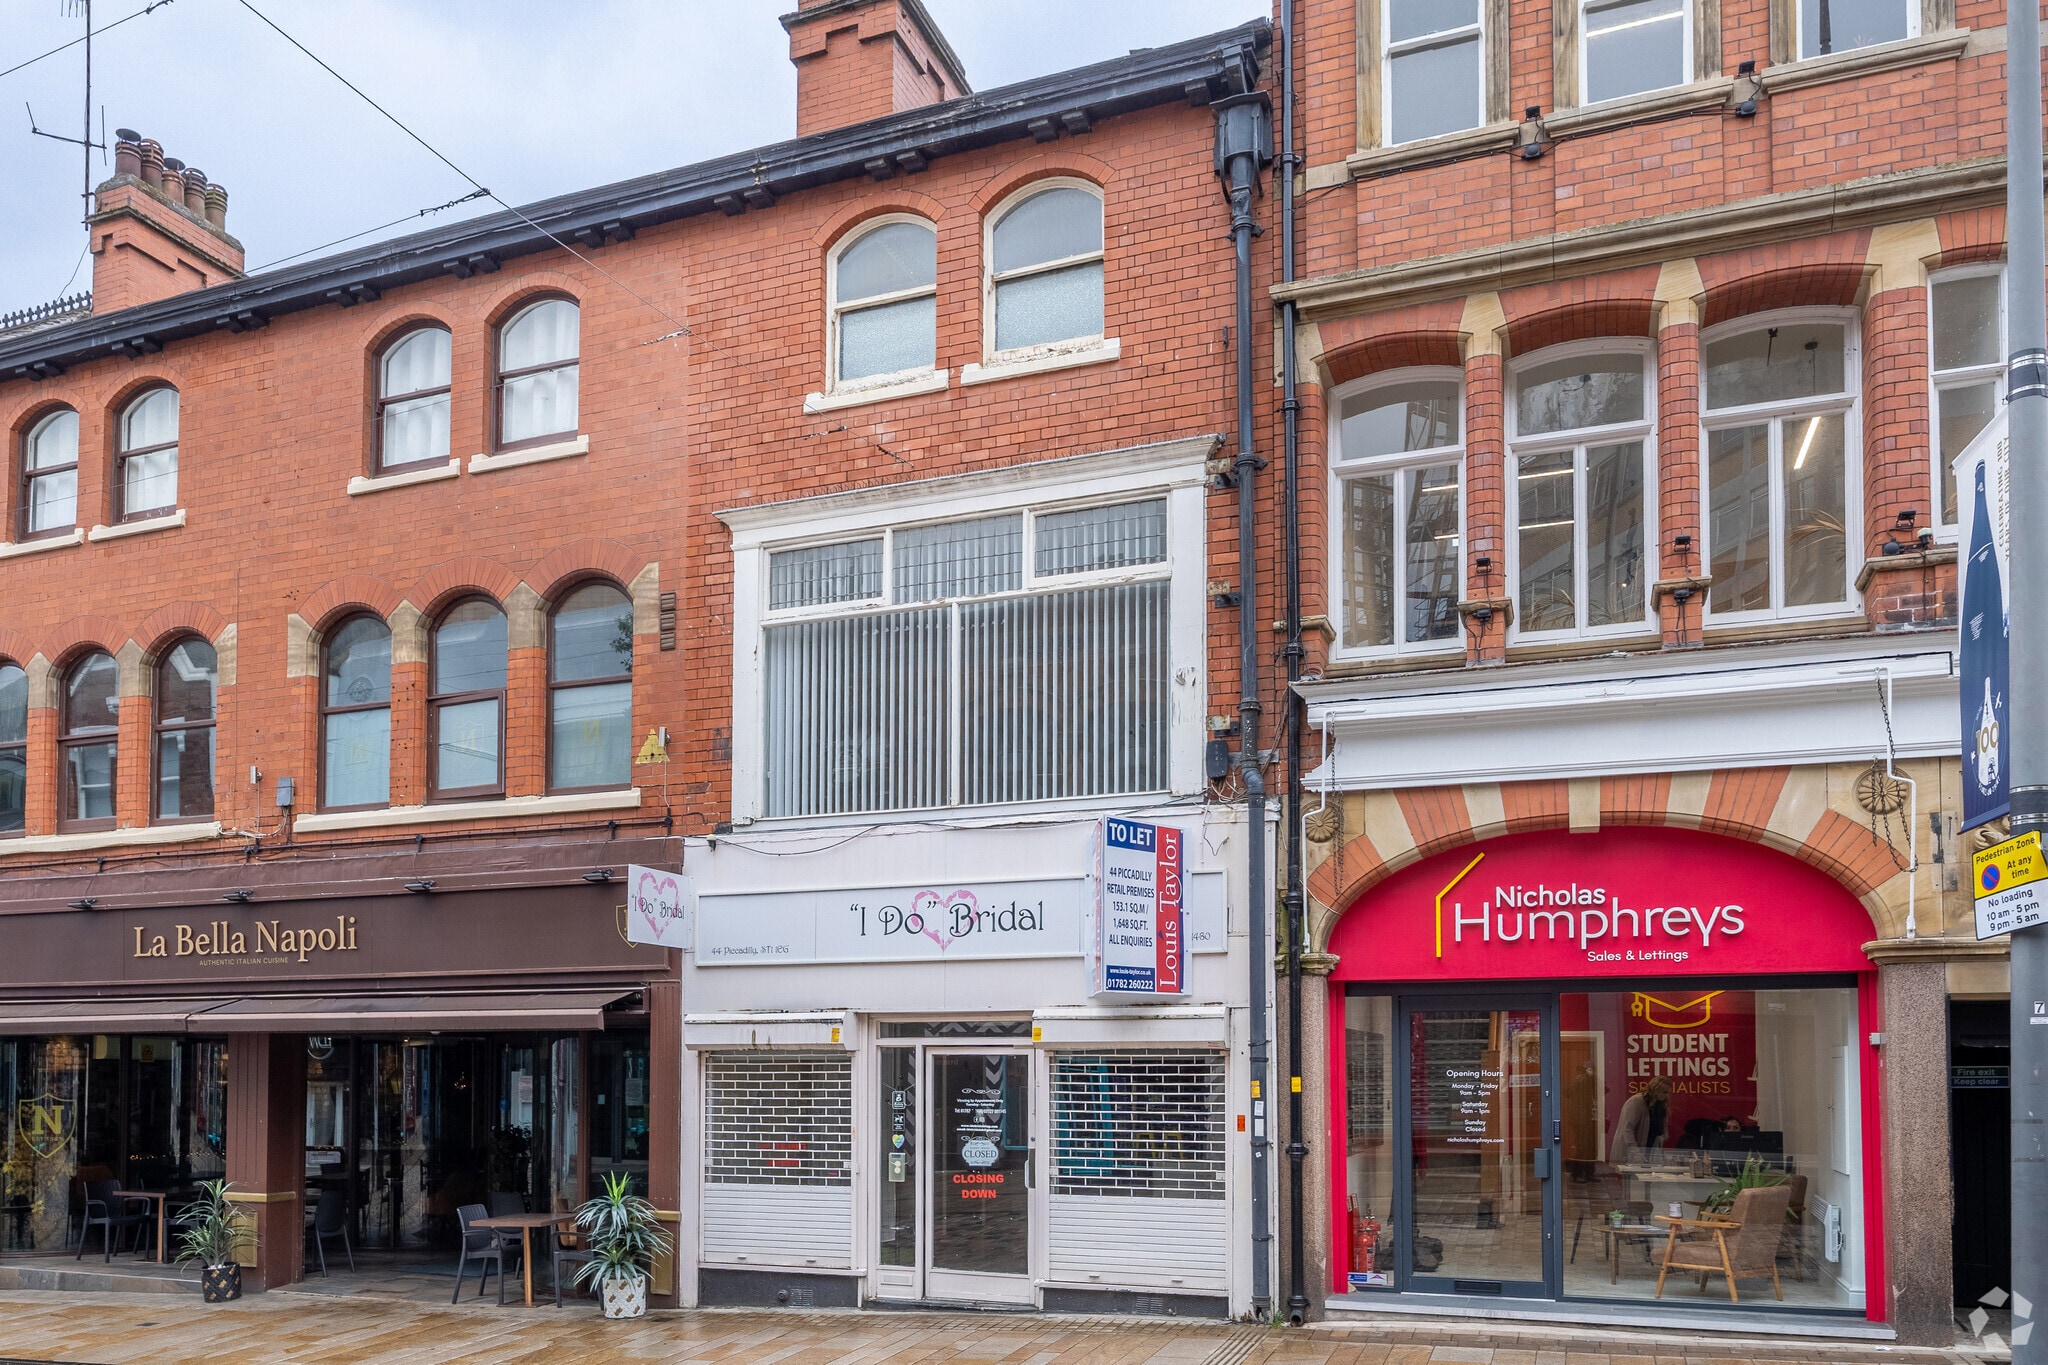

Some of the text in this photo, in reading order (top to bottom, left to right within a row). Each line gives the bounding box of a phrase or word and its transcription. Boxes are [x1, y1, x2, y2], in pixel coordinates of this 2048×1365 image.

[1976, 721, 1999, 756] 100
[1109, 822, 1153, 846] TO LET
[1976, 837, 2035, 865] Pedestrian Zone
[2007, 855, 2032, 869] At any
[1109, 866, 1153, 882] 44 PICCADILLY
[2011, 868, 2029, 879] time
[1107, 883, 1155, 898] RETAIL PREMISES
[1495, 883, 1606, 908] Nicholas
[1988, 888, 2033, 908] No loading
[659, 900, 685, 919] Bridal
[1113, 901, 1129, 912] 153.1
[1159, 833, 1183, 987] Louis Taylor
[1987, 911, 1997, 921] 10
[1998, 909, 2010, 918] am
[2016, 903, 2023, 913] 5
[2024, 901, 2040, 912] pm
[949, 900, 1044, 938] Bridal
[1113, 918, 1129, 929] 1,648
[1454, 897, 1745, 950] Humphreys
[1990, 922, 1996, 931] 9
[1997, 919, 2010, 931] pm
[2016, 915, 2023, 925] 5
[2024, 912, 2040, 922] am
[133, 915, 358, 962] La Bella Napoli
[1109, 934, 1153, 947] ALL ENQUIRIES
[199, 956, 289, 967] AUTHENTIC ITALIAN CUISINE
[1587, 950, 1689, 963] Sales & Lettings
[1107, 978, 1154, 990] 01782 260222
[2034, 1002, 2044, 1013] 7
[1627, 1033, 1729, 1054] STUDENT
[1446, 1069, 1504, 1078] Opening Hours
[1627, 1057, 1730, 1077] LETTINGS
[1628, 1081, 1731, 1094] SPIALISTS
[1953, 1078, 1976, 1086] Keep
[32, 1105, 65, 1135] N
[964, 1150, 997, 1158] CLOSED
[952, 1174, 1005, 1184] CLOSING
[961, 1189, 997, 1198] DOWN
